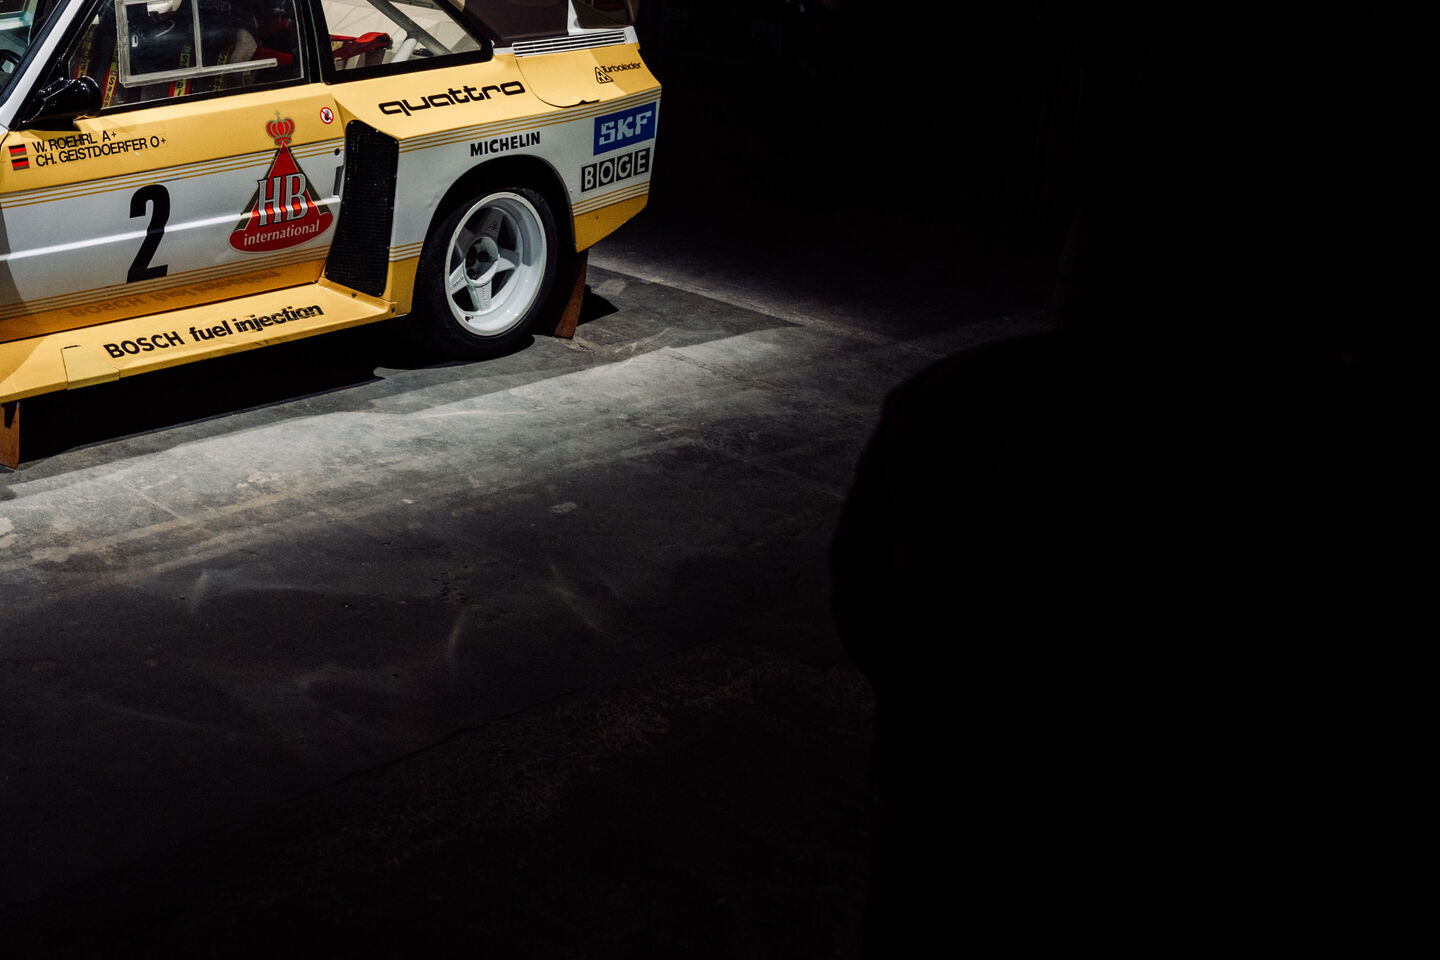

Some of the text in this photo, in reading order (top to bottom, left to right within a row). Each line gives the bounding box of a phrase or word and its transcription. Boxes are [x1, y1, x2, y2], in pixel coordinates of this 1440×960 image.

[378, 80, 526, 116] quattro
[32, 141, 48, 154] W.
[49, 132, 98, 150] ROEHRL
[470, 131, 541, 157] MICHELIN
[599, 110, 652, 146] SKF
[35, 153, 58, 167] CH.
[59, 137, 148, 162] GEISTDOERFER
[582, 149, 649, 191] BOGE
[257, 172, 309, 227] HB
[126, 184, 171, 285] 2
[243, 218, 321, 246] international
[103, 303, 325, 359] BOSCH fuel injection
